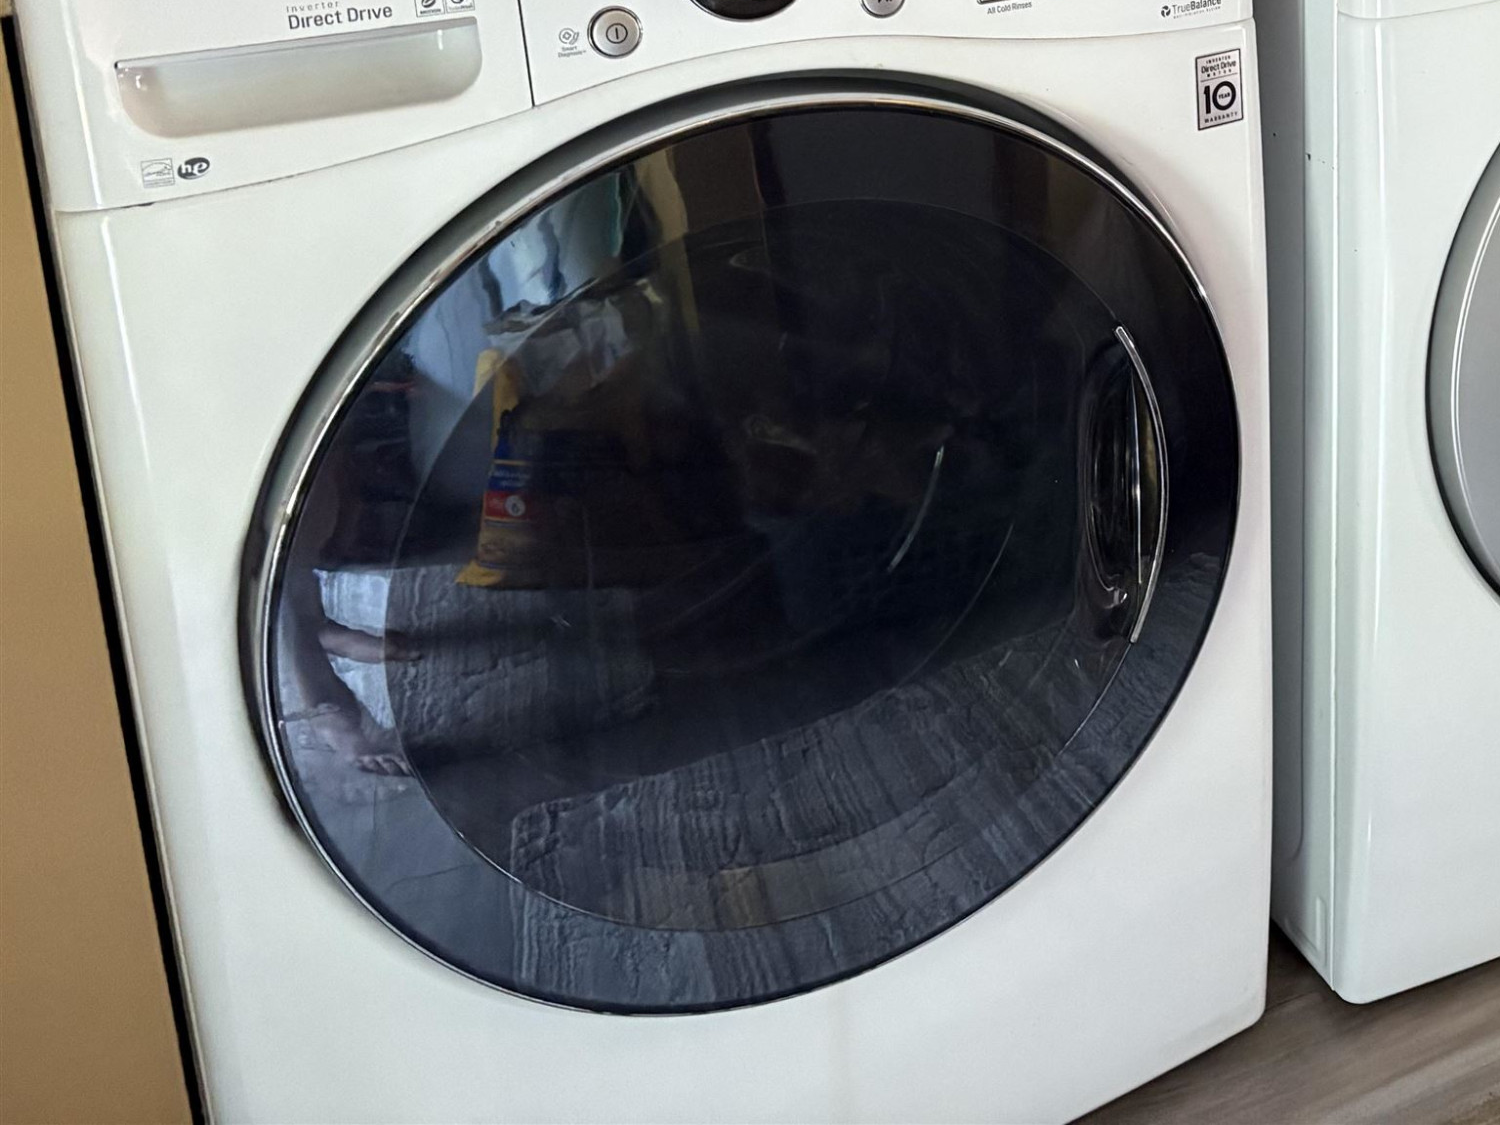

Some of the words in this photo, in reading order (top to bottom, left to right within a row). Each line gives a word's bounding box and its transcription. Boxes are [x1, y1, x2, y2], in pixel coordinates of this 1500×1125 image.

[286, 1, 340, 13] Inverter
[987, 6, 995, 15] All
[996, 4, 1011, 13] Cold
[1012, 1, 1032, 11] Rinses
[288, 11, 343, 30] Direct
[347, 6, 393, 22] Drive
[1201, 64, 1220, 74] Direct
[1221, 60, 1236, 69] Drive
[1204, 81, 1236, 114] 10
